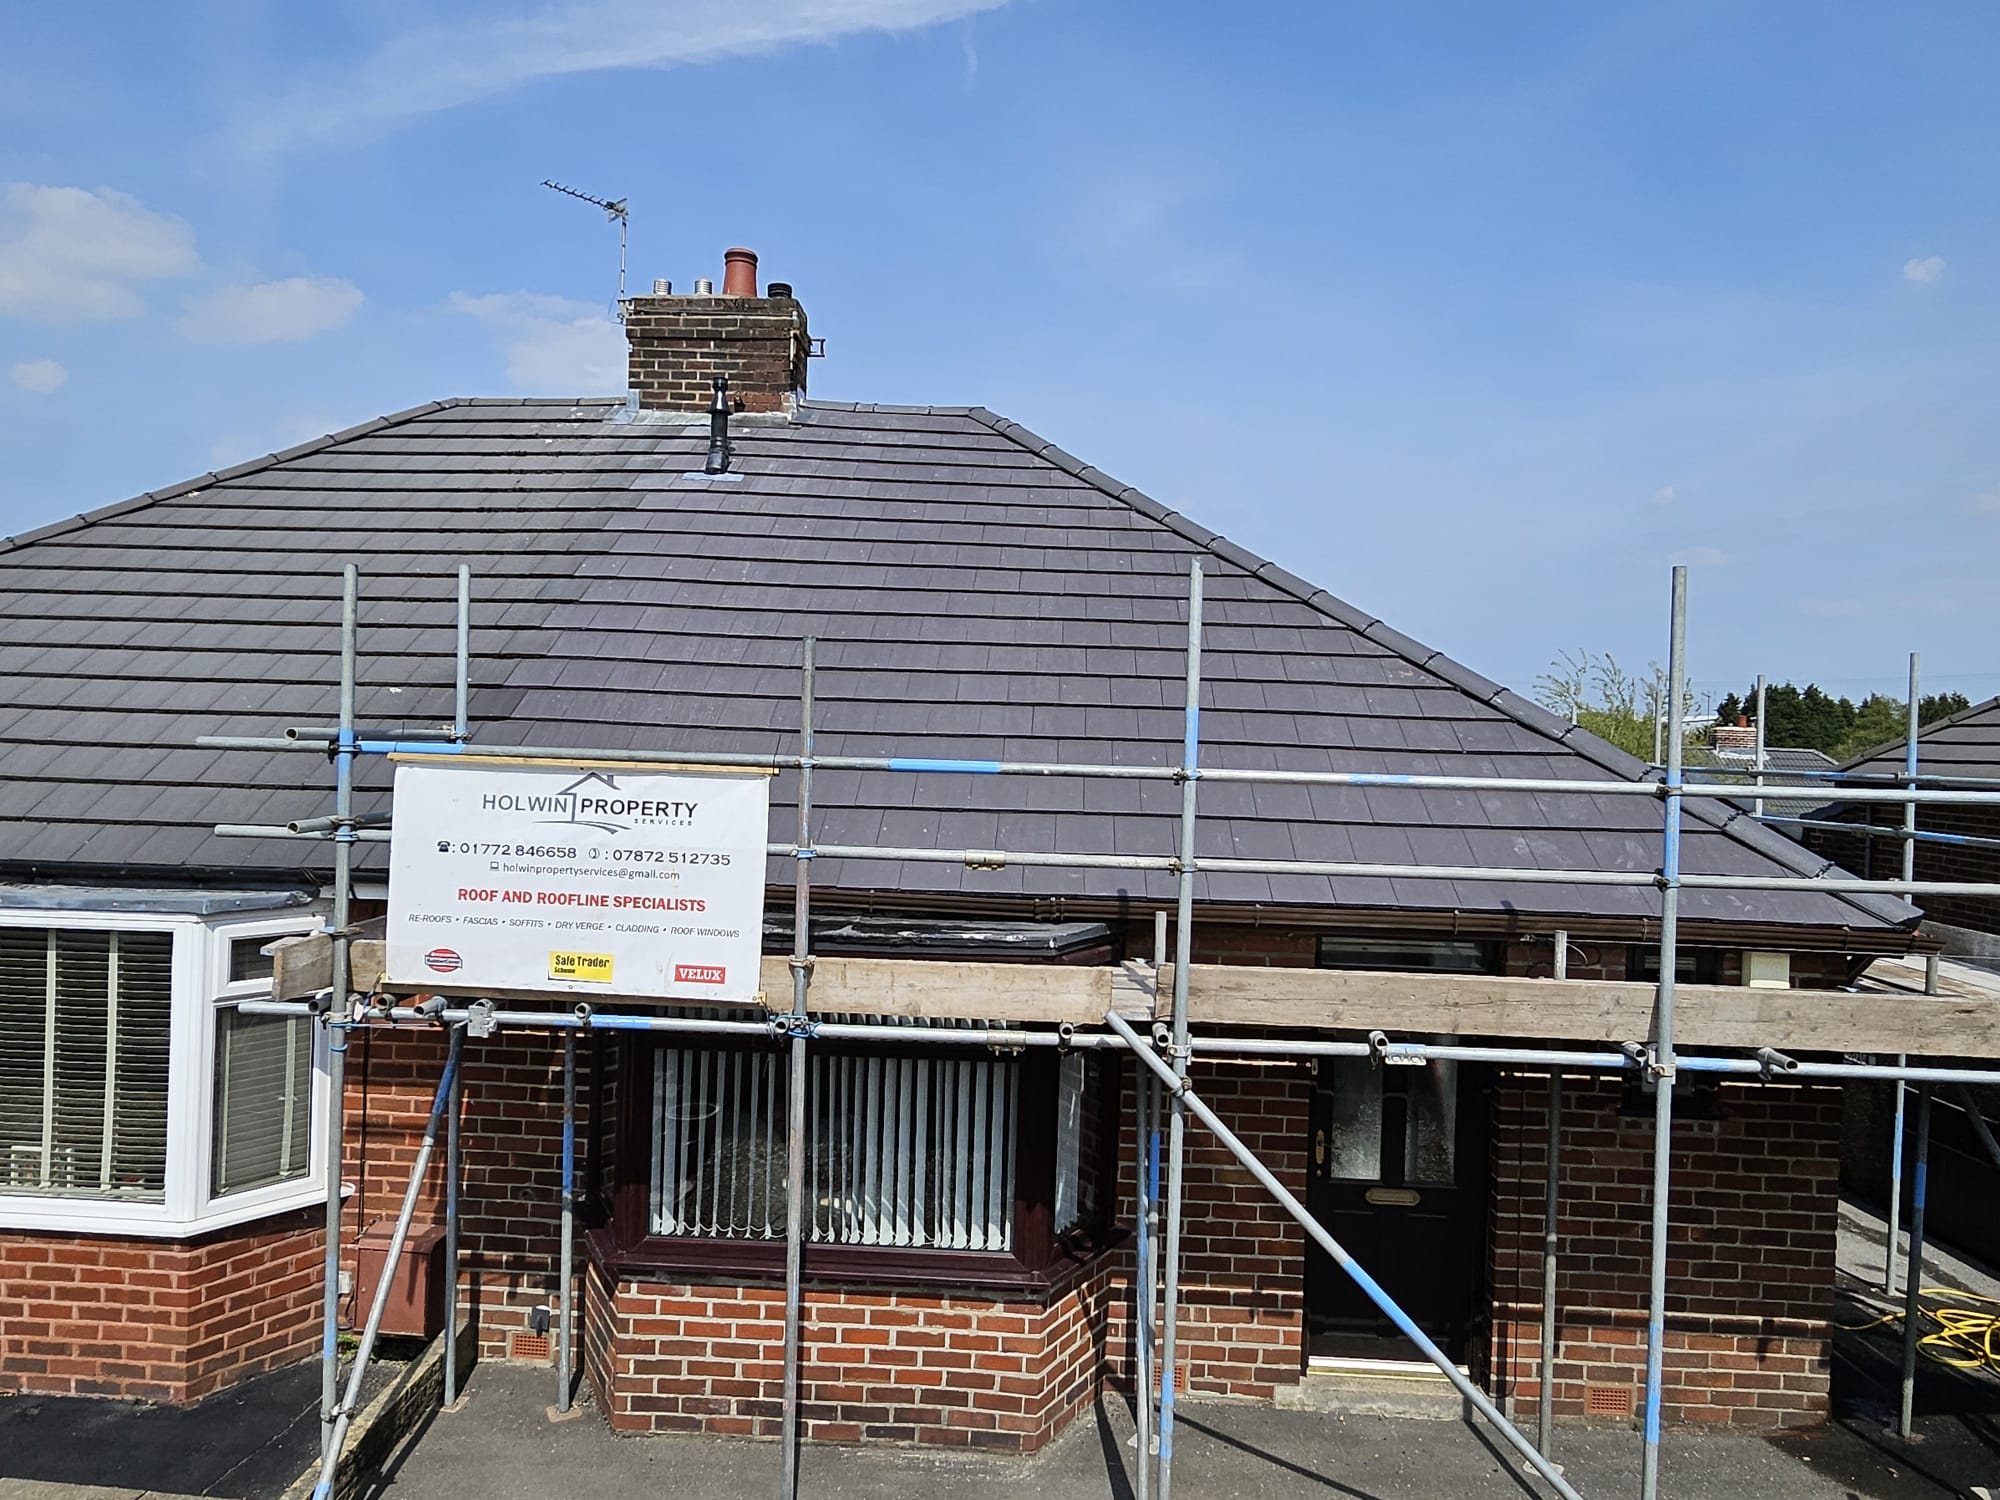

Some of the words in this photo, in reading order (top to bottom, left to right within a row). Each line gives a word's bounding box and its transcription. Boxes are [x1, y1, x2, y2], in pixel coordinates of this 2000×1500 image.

[482, 794, 568, 813] HOLWIN
[580, 798, 698, 818] PROPERTY
[633, 818, 693, 826] SERVICES
[460, 843, 511, 856] 01772
[515, 845, 577, 859] 846658
[613, 849, 664, 863] 07872
[668, 852, 731, 866] 512735
[503, 863, 680, 881] holwinpropertyservices@gmail.com
[458, 889, 498, 901] ROOF
[502, 891, 532, 903] AND
[537, 892, 609, 907] ROOFLINE
[613, 895, 706, 912] SPECIALISTS
[408, 913, 452, 923] RE-ROOFS
[463, 916, 498, 926] FASCIAS
[509, 919, 544, 928] SOFFITS
[555, 921, 573, 930] DRY
[575, 922, 605, 931] VERGE
[615, 923, 660, 934] CLADDING
[670, 926, 695, 936] ROOF
[697, 927, 740, 938] WINDOWS
[554, 955, 575, 966] Safe
[577, 956, 610, 968] Trader
[679, 967, 722, 981] VELUX
